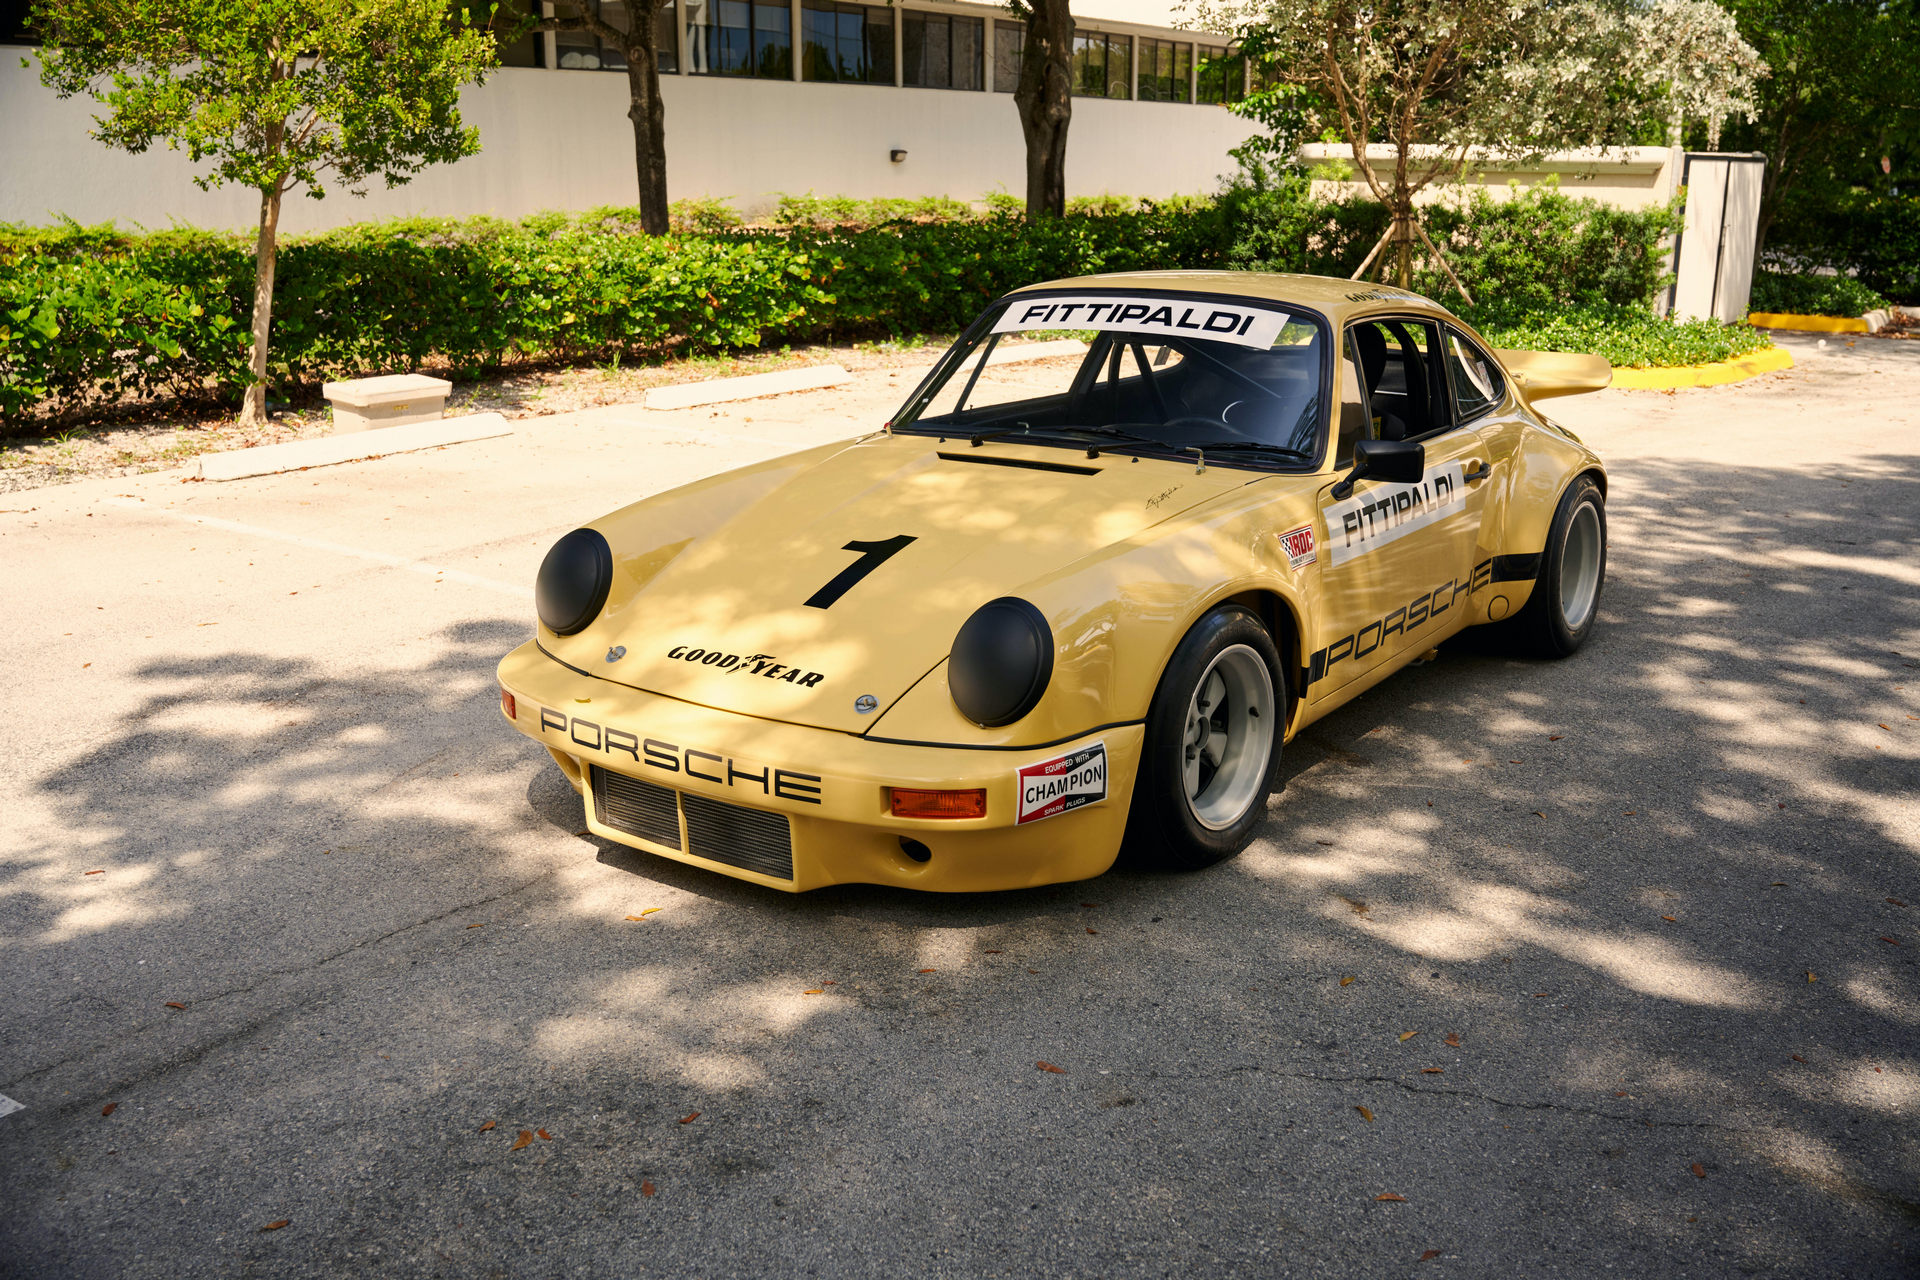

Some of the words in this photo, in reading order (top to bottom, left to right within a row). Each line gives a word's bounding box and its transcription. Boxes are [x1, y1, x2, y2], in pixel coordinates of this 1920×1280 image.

[1018, 303, 1255, 336] FITTIPALDI
[1342, 473, 1455, 548] FITTIPALDI
[1288, 530, 1313, 558] IROC
[802, 534, 919, 609] 1
[1324, 558, 1492, 677] PORSCHE
[541, 707, 821, 805] PORSCHE
[1044, 758, 1074, 774] EQUIPPED
[1075, 753, 1090, 764] WITH
[1025, 764, 1102, 804] CHAMPION
[1044, 804, 1064, 815] SPARK
[1066, 797, 1086, 808] PLUGS
